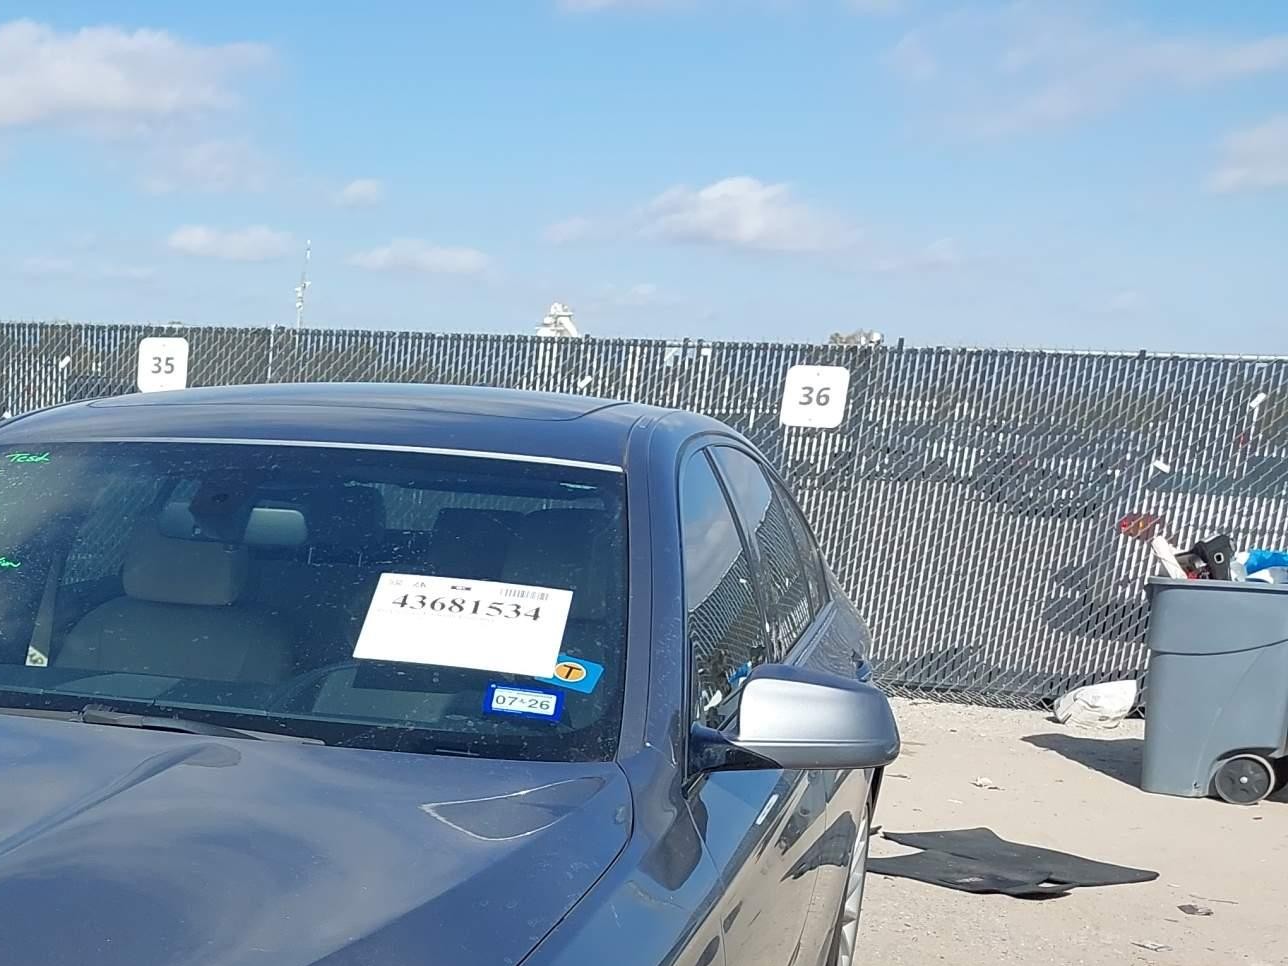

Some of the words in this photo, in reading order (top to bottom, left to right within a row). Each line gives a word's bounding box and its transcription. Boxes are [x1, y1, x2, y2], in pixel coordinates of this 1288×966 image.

[151, 356, 175, 375] 35
[798, 385, 831, 407] 36
[392, 593, 541, 621] 43681534
[563, 664, 583, 680] T
